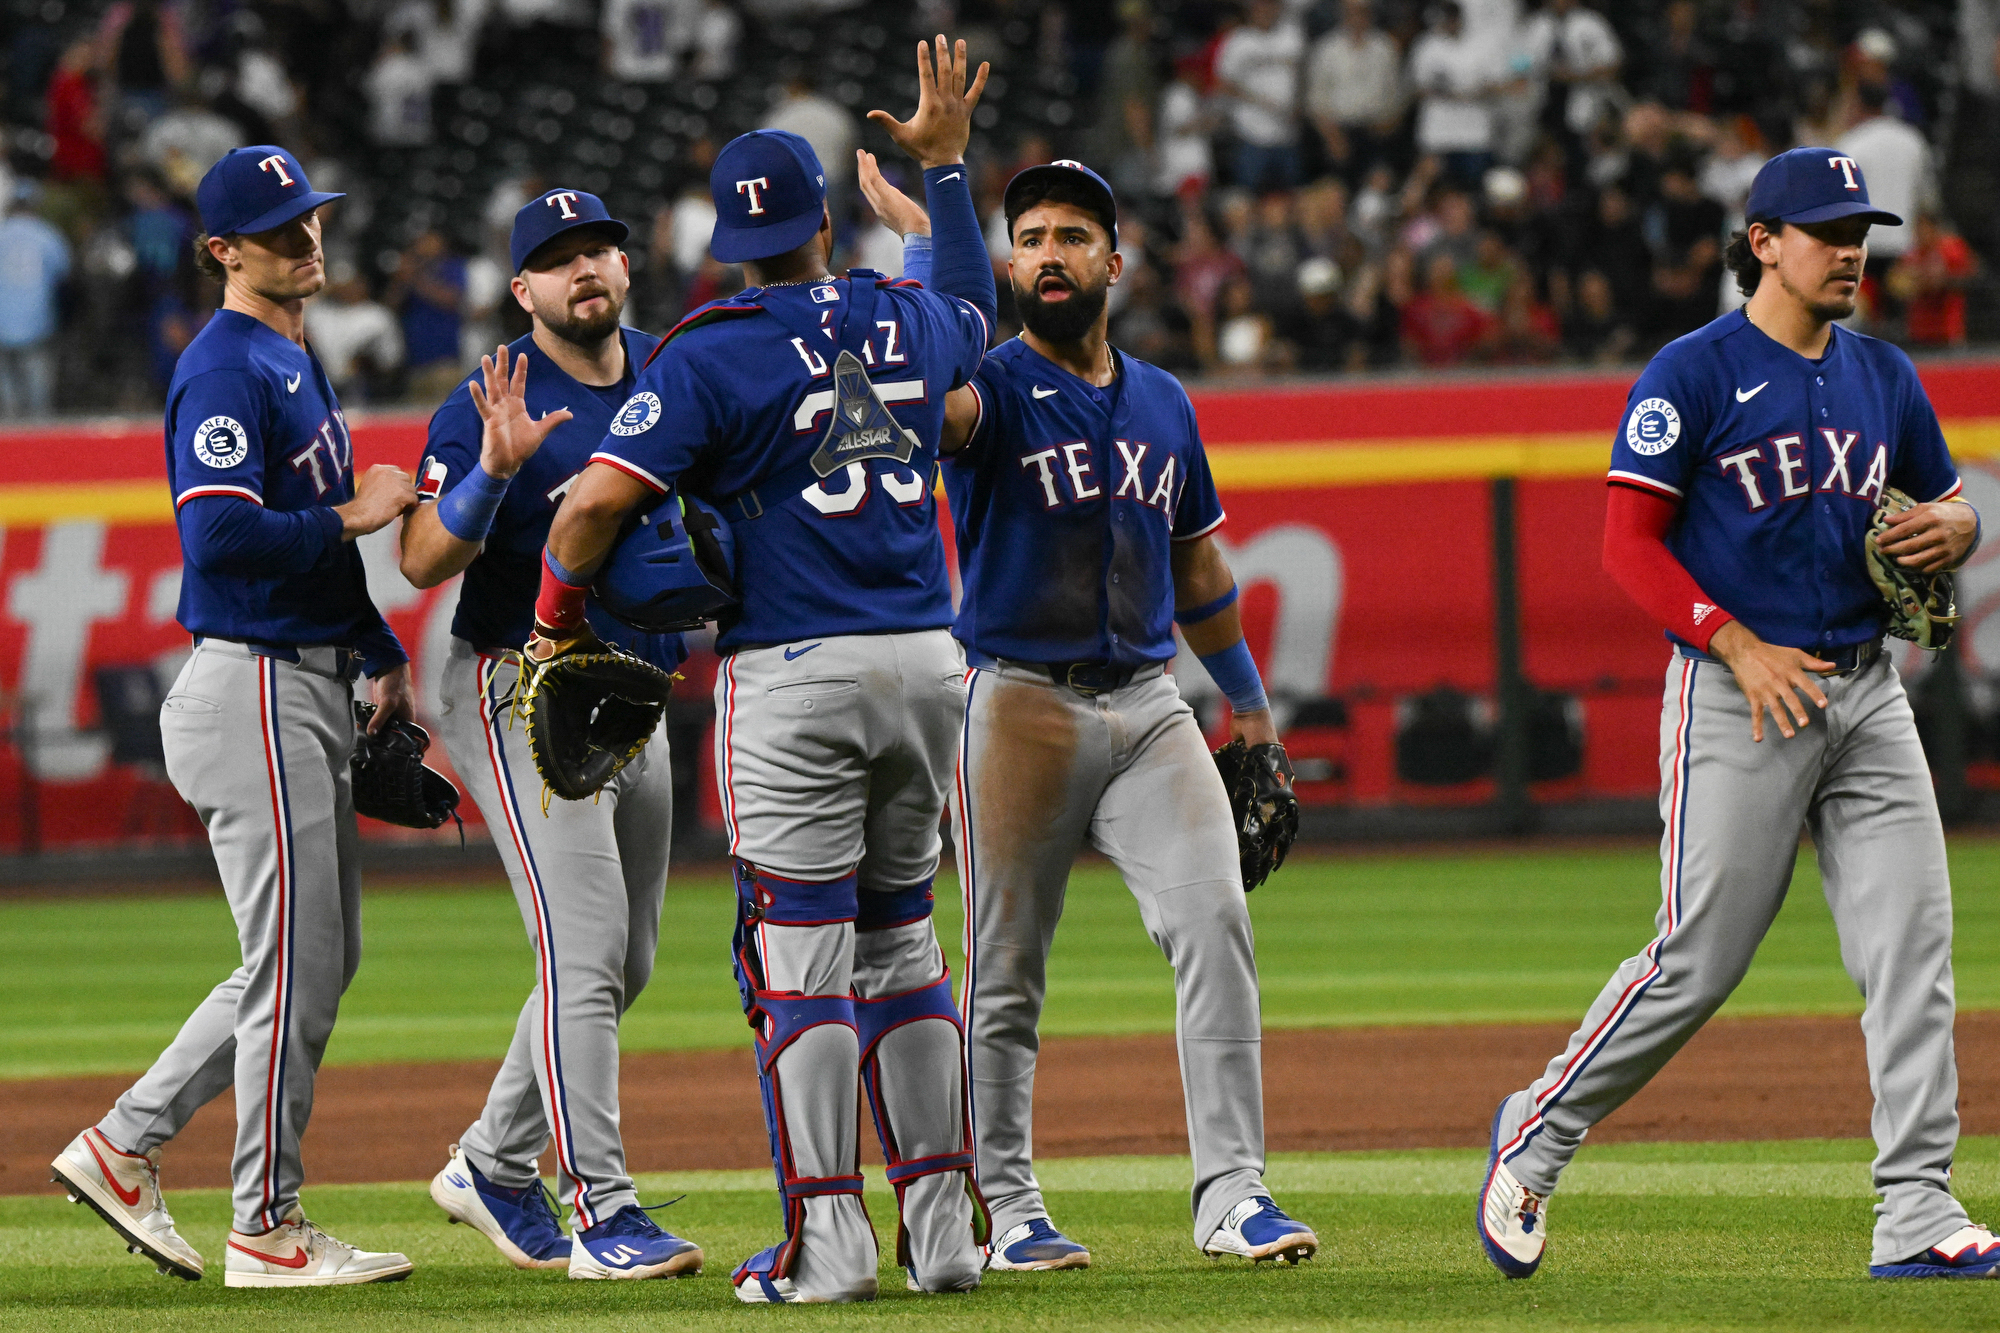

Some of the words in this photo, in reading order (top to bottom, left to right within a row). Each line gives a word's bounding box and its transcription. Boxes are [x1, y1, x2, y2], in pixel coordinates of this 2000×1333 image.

[258, 155, 295, 187] T
[1828, 156, 1859, 190] T
[546, 193, 579, 220] T
[736, 177, 769, 216] T
[1635, 400, 1679, 424] ENERGY
[199, 418, 245, 436] ENERGY
[837, 427, 892, 451] ALL-STAR
[1629, 426, 1677, 454] TRANSFER
[197, 445, 246, 467] TRANSFER
[1020, 440, 1188, 532] TEXA
[1694, 605, 1717, 626] adidas
